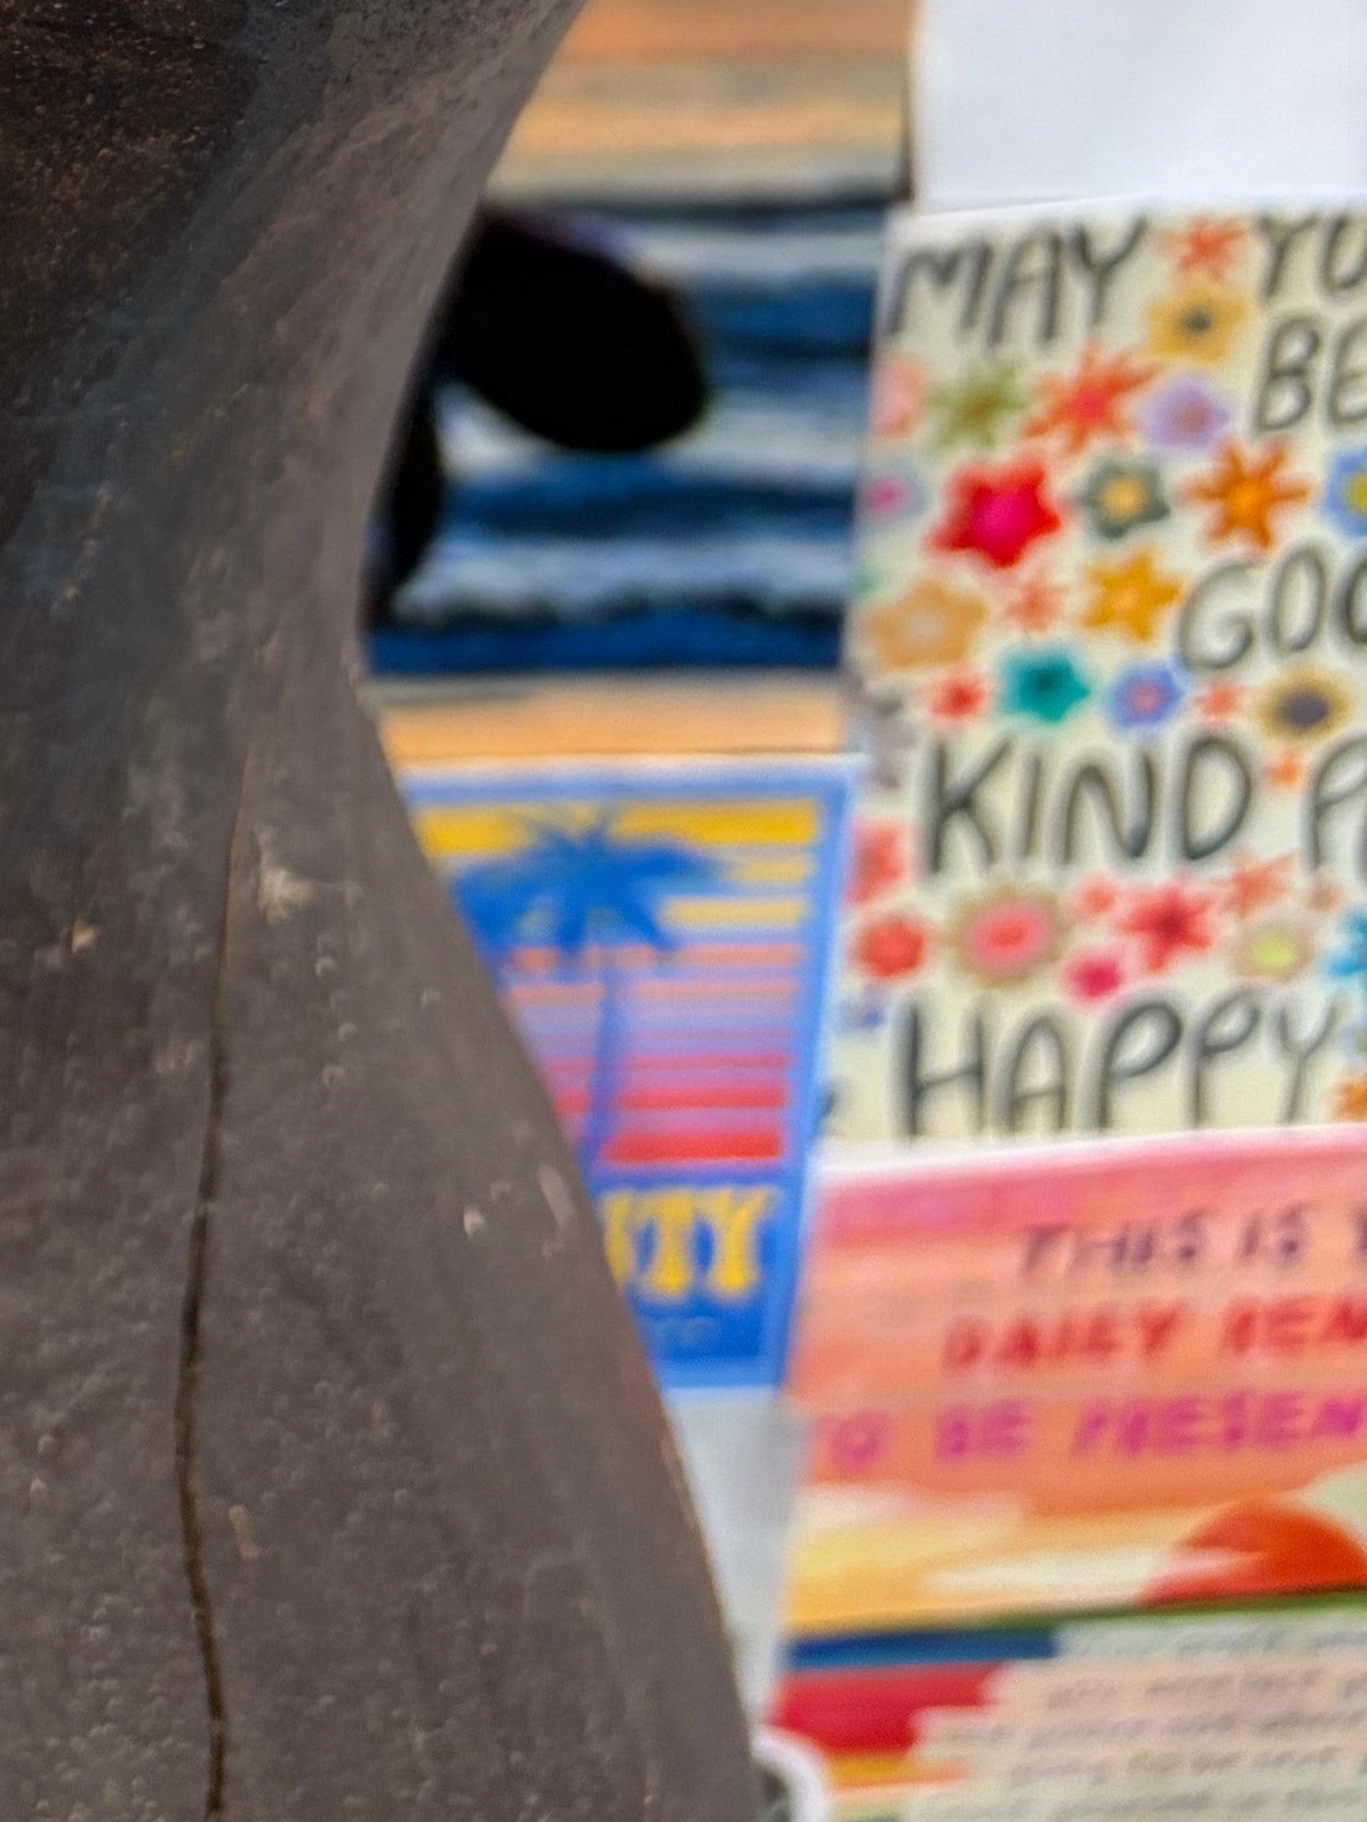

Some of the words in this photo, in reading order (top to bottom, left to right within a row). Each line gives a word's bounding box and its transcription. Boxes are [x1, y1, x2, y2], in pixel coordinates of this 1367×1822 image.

[885, 214, 1147, 343] MAY
[922, 732, 1255, 878] KIND
[899, 989, 1341, 1138] HAPPY
